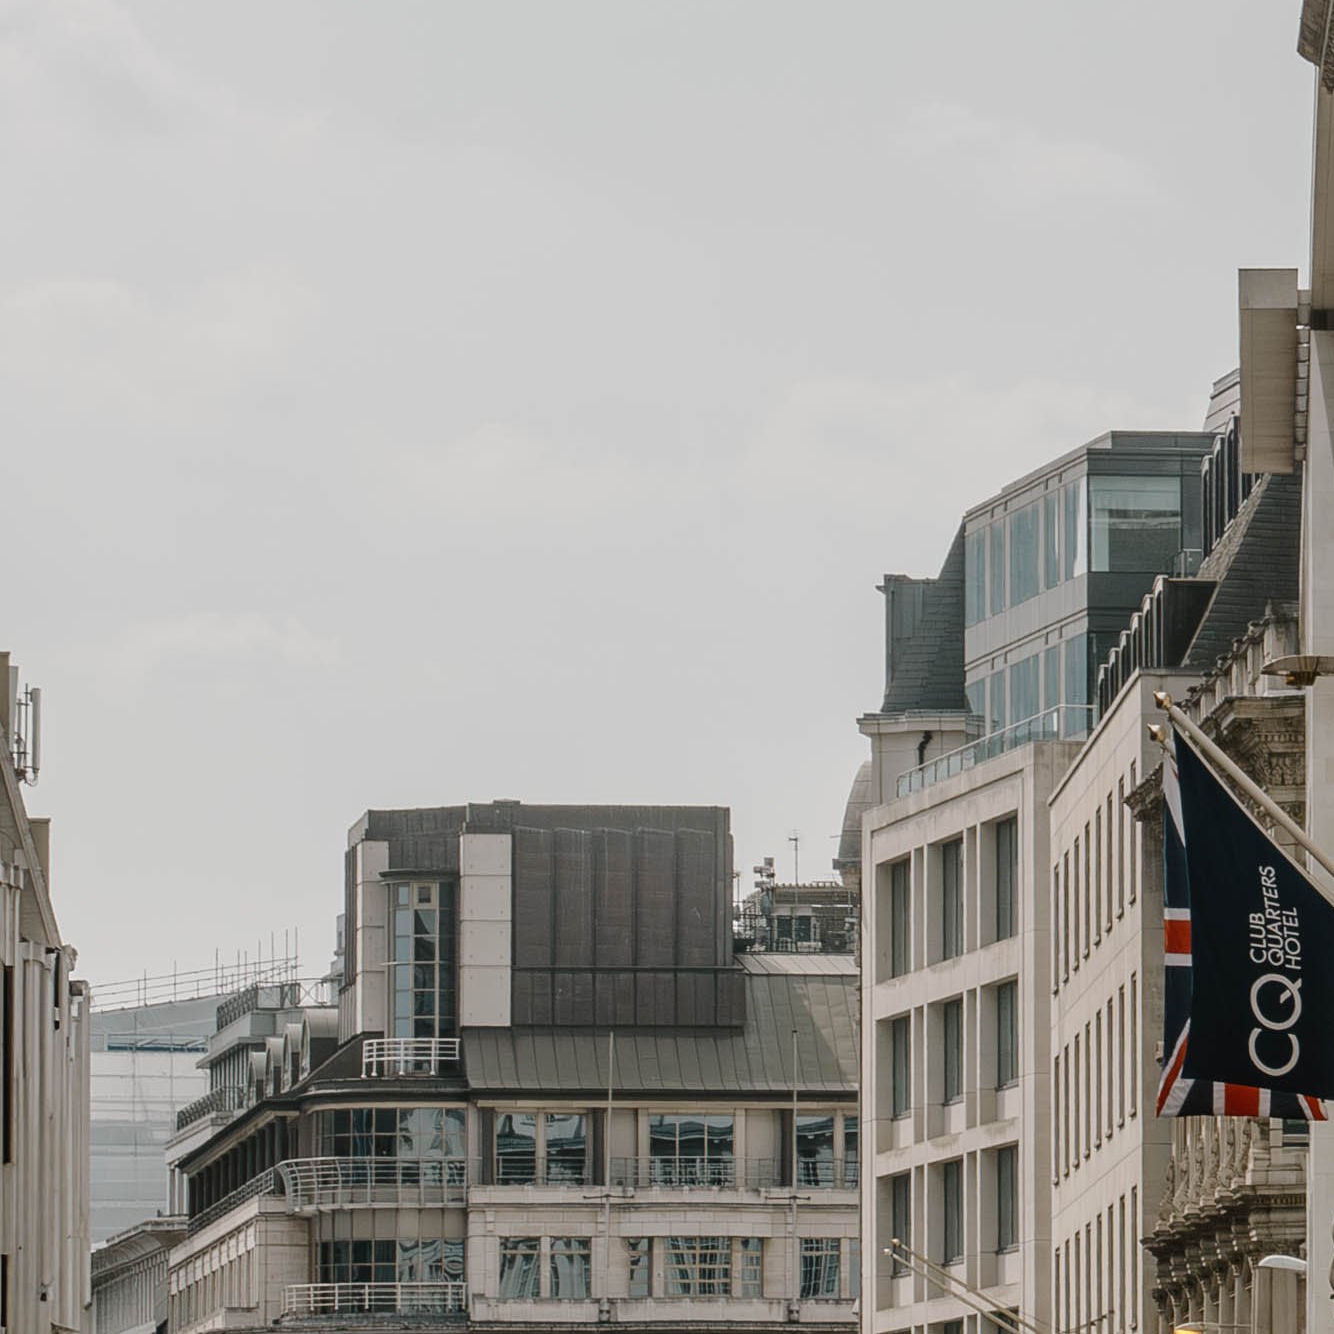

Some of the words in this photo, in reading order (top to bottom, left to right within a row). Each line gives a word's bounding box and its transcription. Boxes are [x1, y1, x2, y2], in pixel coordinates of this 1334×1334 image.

[1250, 912, 1267, 964] CLUB
[1259, 865, 1284, 967] QUARTERS
[1282, 906, 1302, 970] HOTEL
[1248, 973, 1302, 1077] CQ
